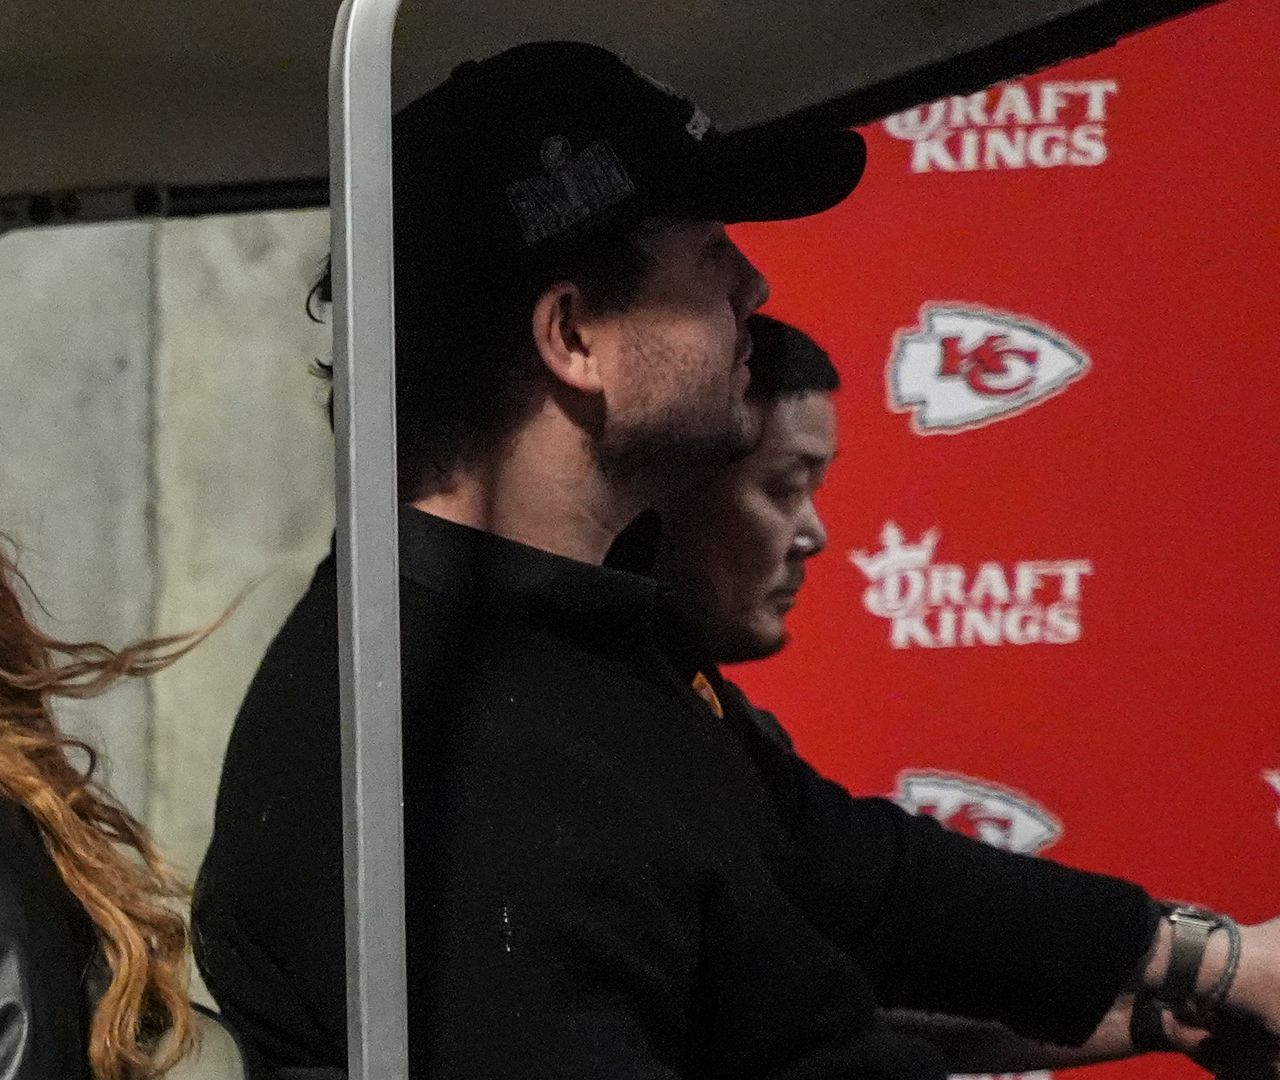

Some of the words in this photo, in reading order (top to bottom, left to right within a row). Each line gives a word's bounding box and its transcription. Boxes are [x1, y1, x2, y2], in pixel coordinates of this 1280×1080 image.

[884, 79, 1119, 140] DRAFT
[910, 128, 1108, 173] KINGS
[862, 558, 1094, 618] DRAFT
[891, 604, 1082, 649] KINGS
